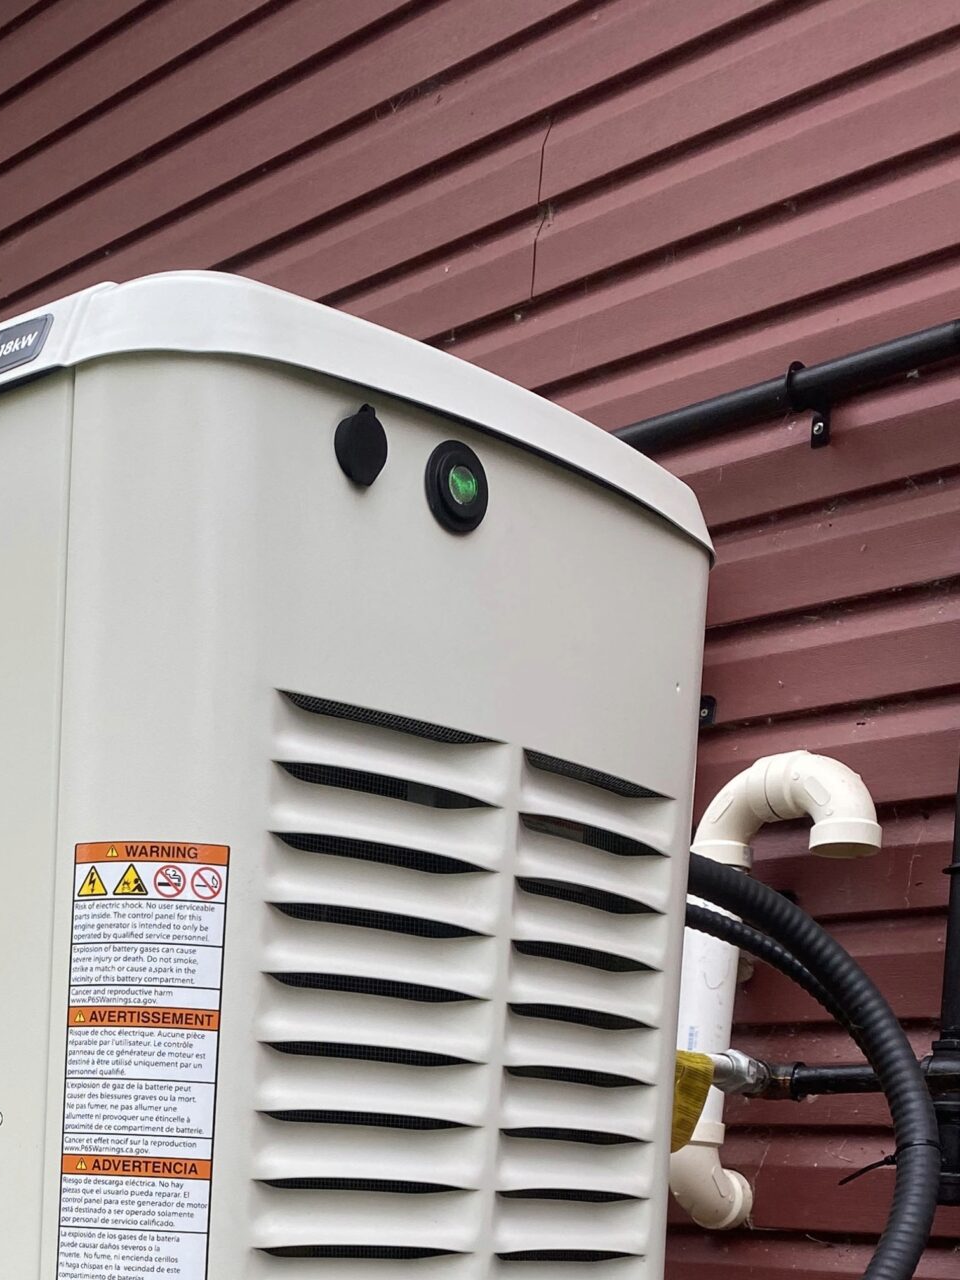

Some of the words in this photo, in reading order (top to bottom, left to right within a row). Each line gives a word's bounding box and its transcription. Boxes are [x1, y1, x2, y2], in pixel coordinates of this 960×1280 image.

[126, 846, 198, 858] WARNING
[90, 1011, 213, 1026] AVERTISSEMENT
[92, 1159, 198, 1175] ADVERTENCIA
